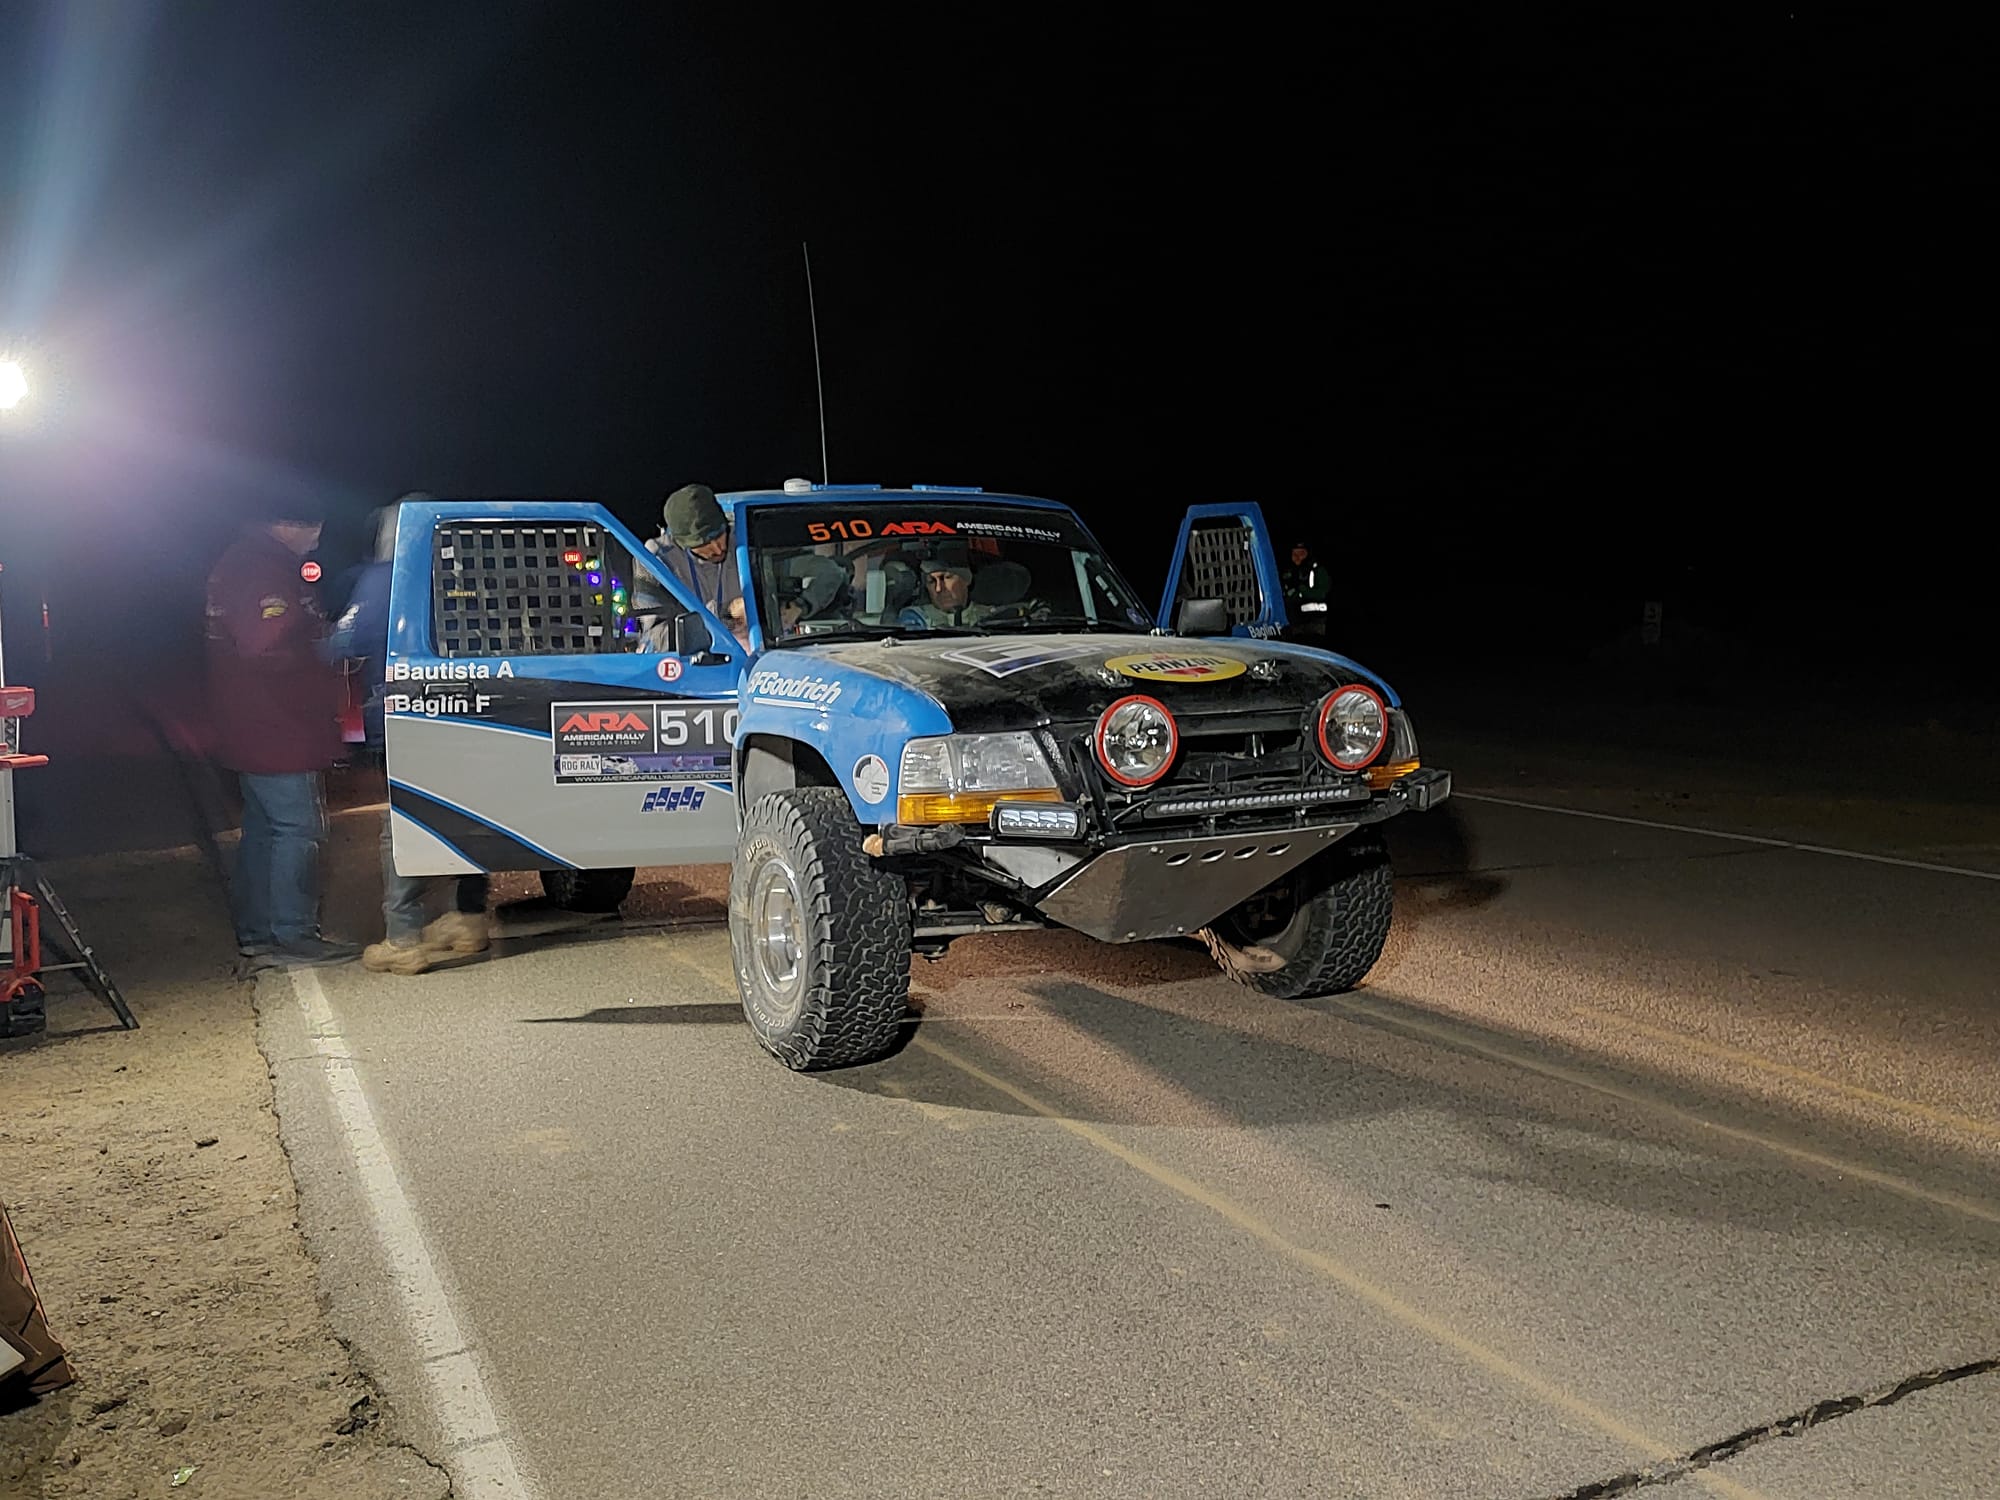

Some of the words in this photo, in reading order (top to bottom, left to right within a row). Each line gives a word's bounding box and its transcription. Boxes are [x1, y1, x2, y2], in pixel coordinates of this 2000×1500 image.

[808, 520, 872, 541] 510
[880, 521, 957, 535] ARA
[956, 522, 1023, 533] AMERICAN
[1024, 527, 1060, 538] RALLY
[394, 661, 490, 681] Bautista
[496, 661, 514, 679] A
[663, 662, 677, 678] E
[1127, 657, 1227, 674] PENNZOIL
[747, 671, 842, 704] BFGoodrich
[394, 694, 469, 718] Baglin
[475, 694, 490, 713] F
[559, 711, 650, 733] ARA
[563, 734, 614, 742] AMERICAN
[580, 760, 600, 771] RALY
[574, 771, 732, 783] WWW.AMERICANRALLYASSOCIATION.OR
